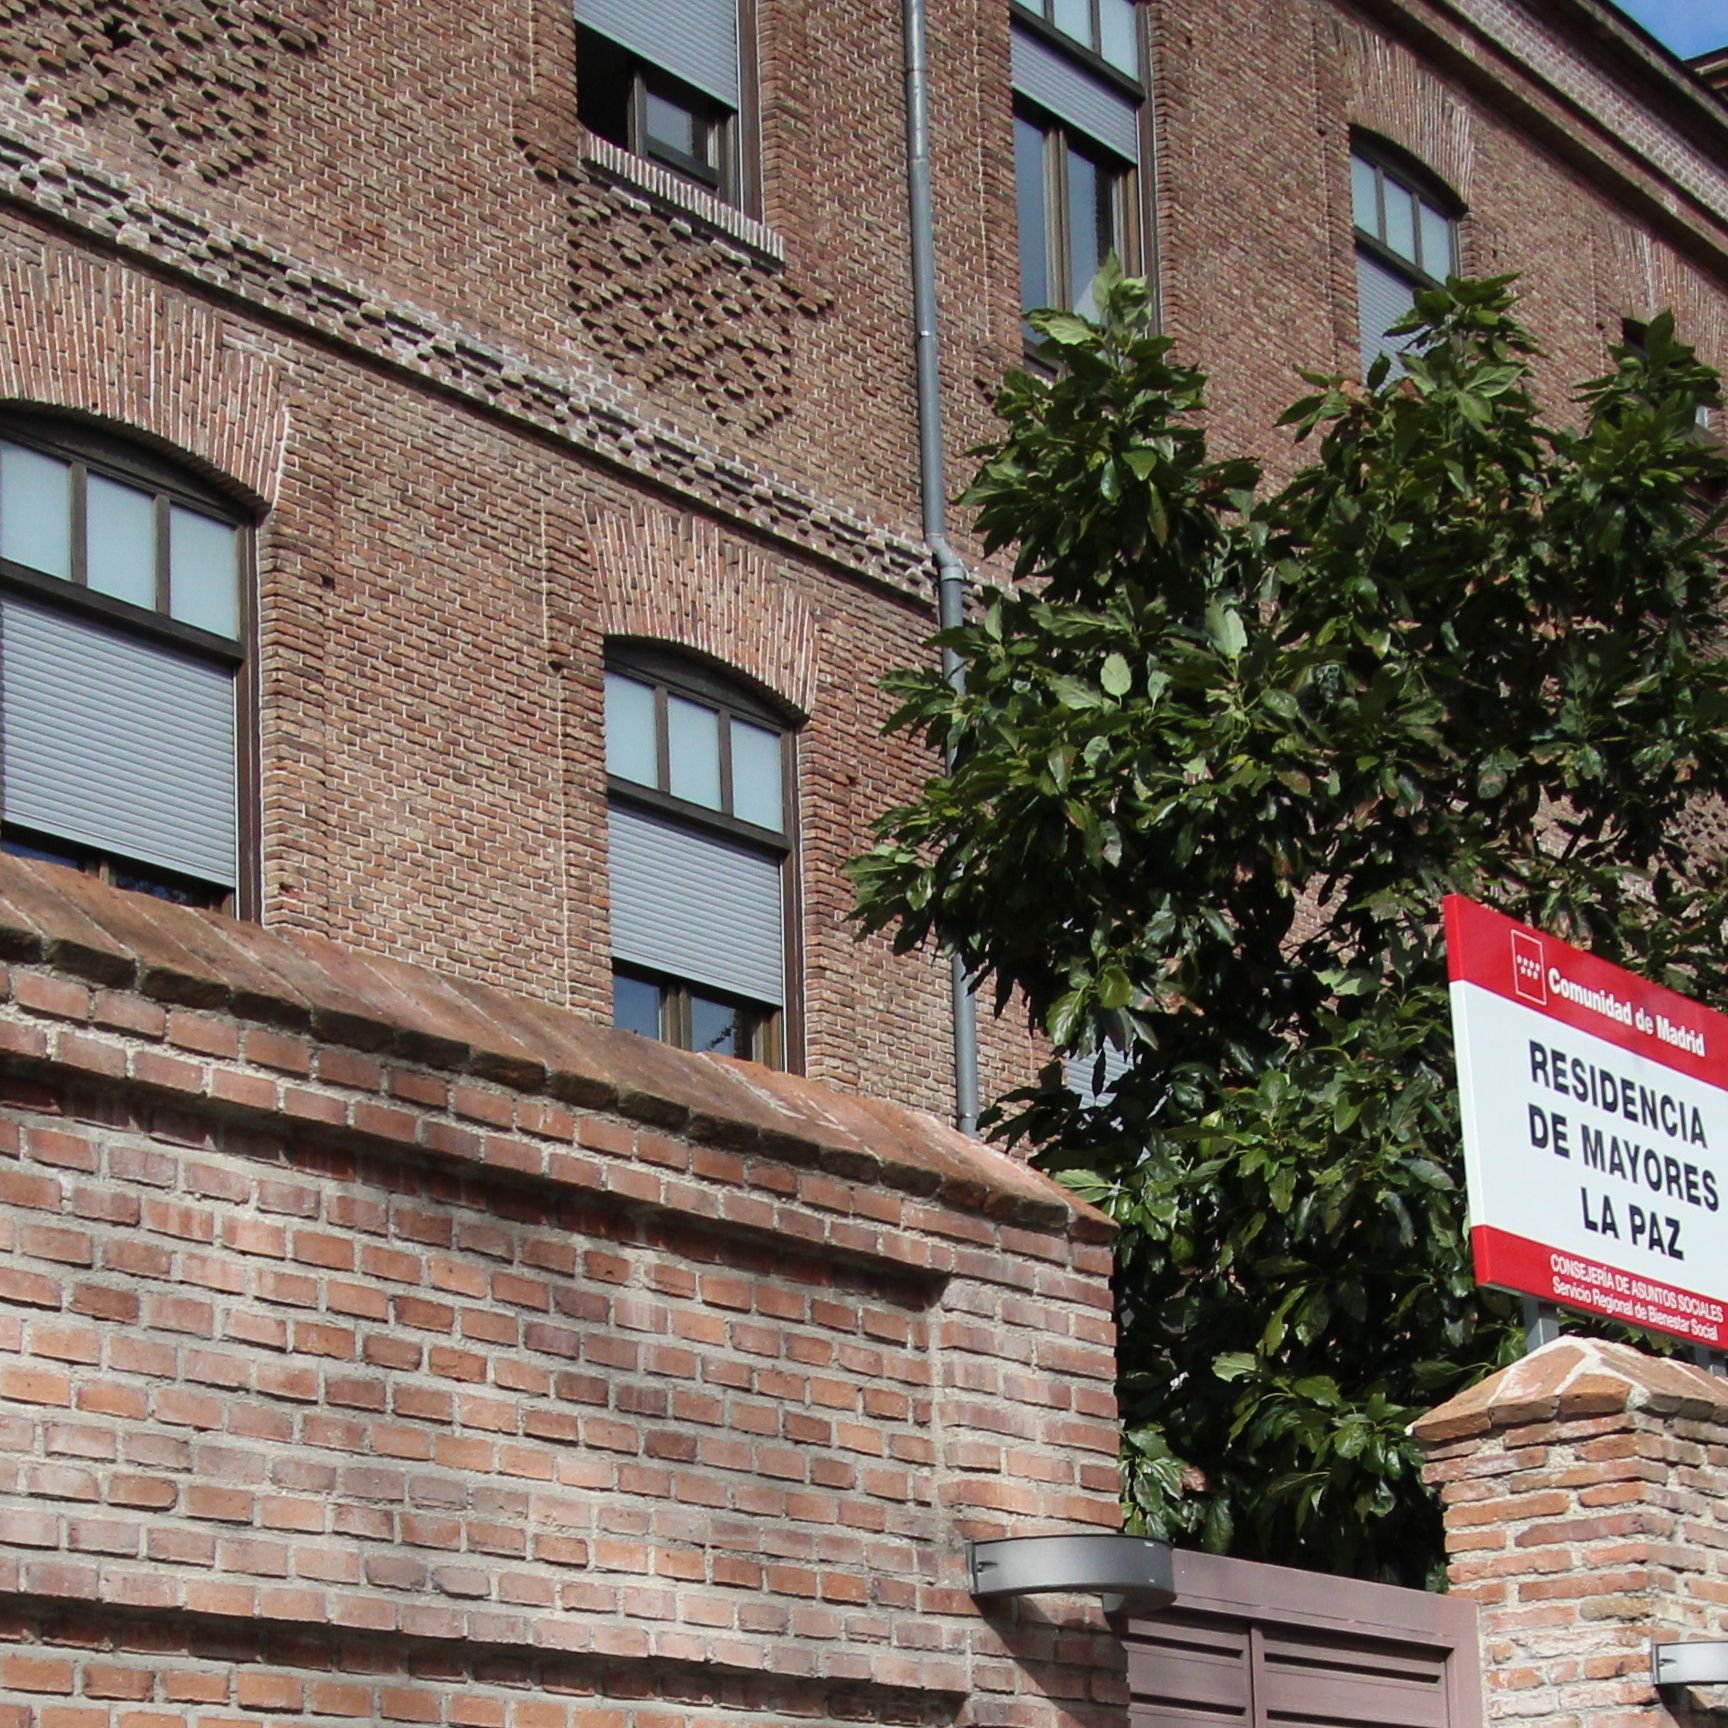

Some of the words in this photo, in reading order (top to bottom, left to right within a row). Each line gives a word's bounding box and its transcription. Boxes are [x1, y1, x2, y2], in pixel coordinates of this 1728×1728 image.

[1548, 967, 1633, 1026] Comunidad
[1635, 1007, 1654, 1035] de
[1656, 1014, 1706, 1057] Madrid
[1529, 1039, 1708, 1150] RESIDENCIA
[1528, 1103, 1570, 1159] DE
[1580, 1123, 1719, 1212] MAYORES
[1580, 1186, 1620, 1240] LA
[1628, 1203, 1685, 1261] PAZ
[1550, 1253, 1615, 1290] CONSEJERÍA
[1615, 1274, 1631, 1295] DE
[1631, 1279, 1677, 1309] ASUNTOS
[1677, 1294, 1724, 1323] SOCIALES
[1552, 1275, 1592, 1303] Servicio
[1592, 1288, 1633, 1316] Regional
[1634, 1301, 1647, 1320] de
[1648, 1305, 1689, 1332] Bienestar
[1691, 1318, 1719, 1341] Social
